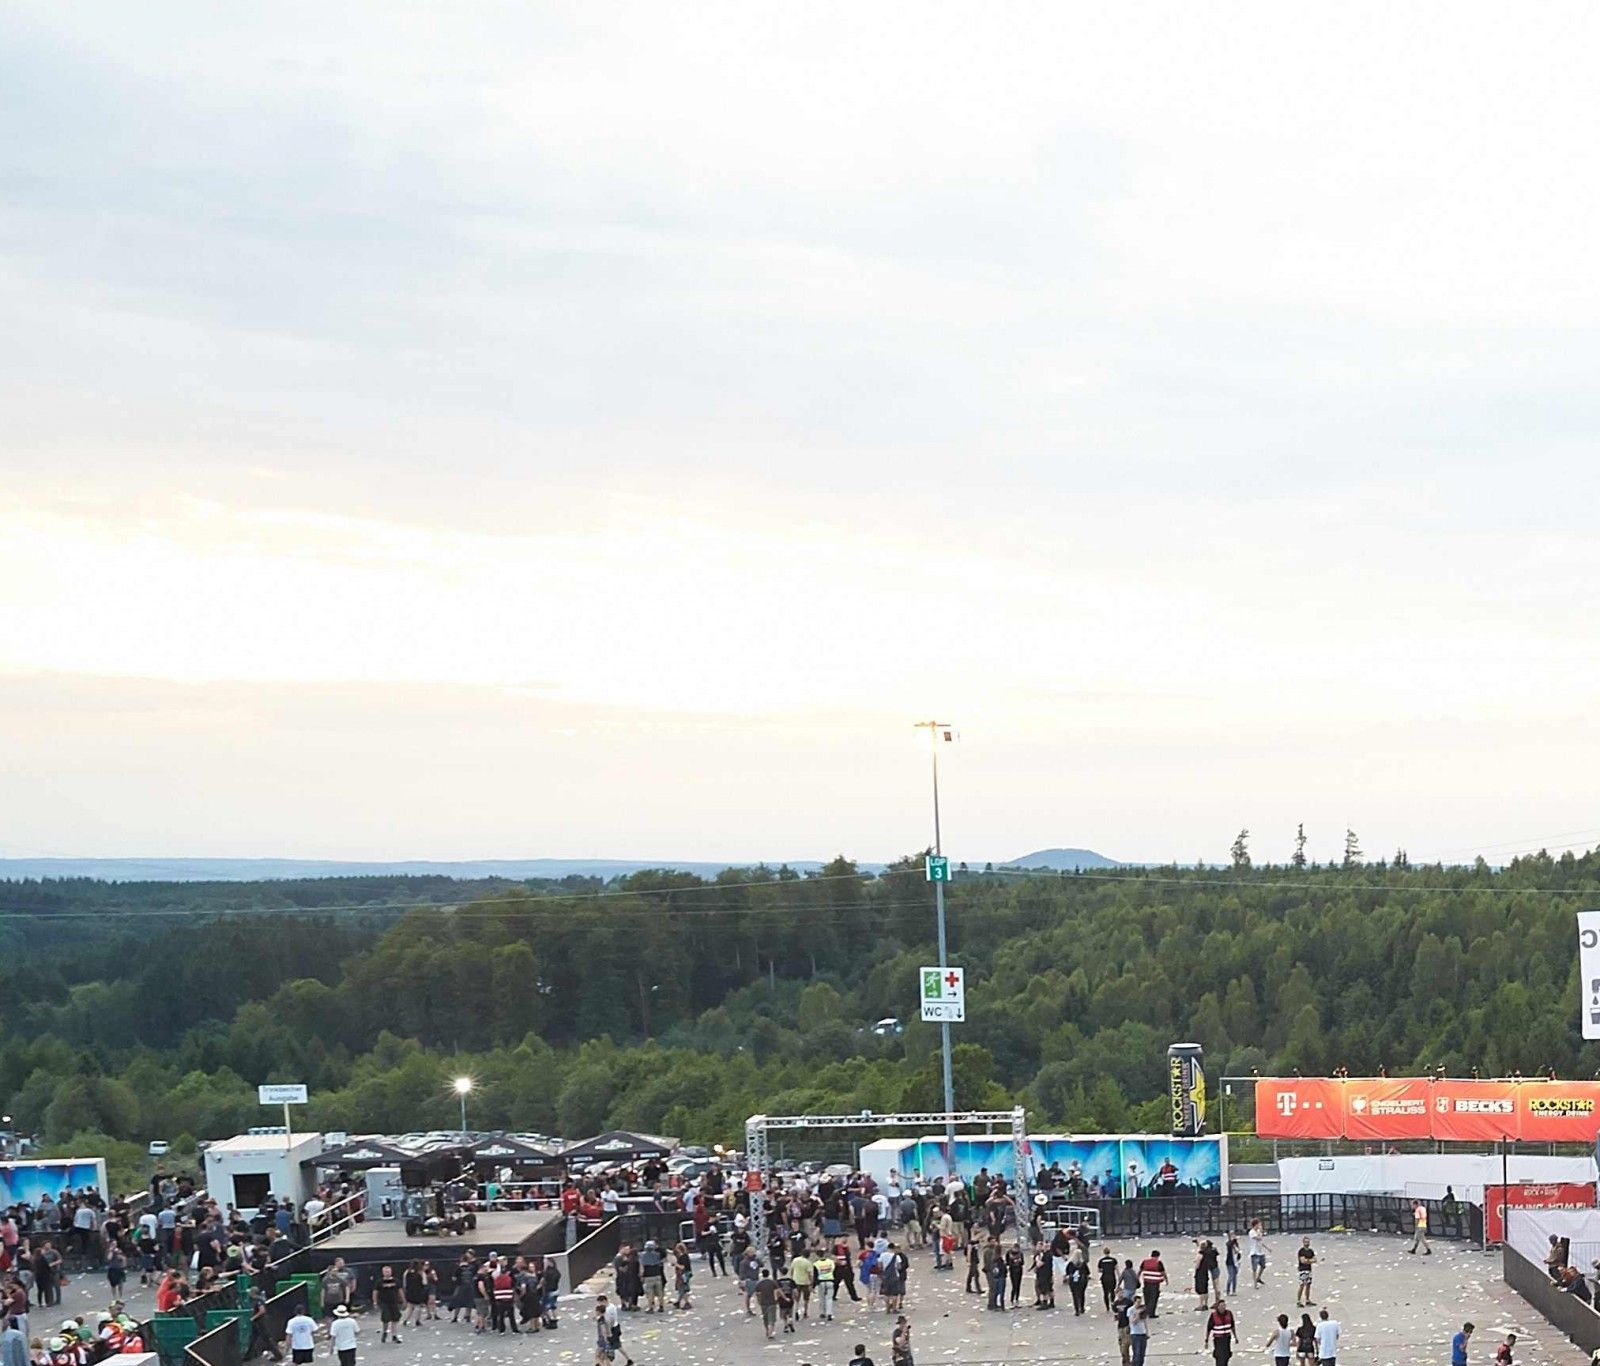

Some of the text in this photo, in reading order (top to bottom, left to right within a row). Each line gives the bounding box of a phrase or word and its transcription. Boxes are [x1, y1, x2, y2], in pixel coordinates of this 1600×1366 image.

[935, 867, 942, 879] 3
[924, 1007, 942, 1017] WC
[1371, 1106, 1426, 1115] STRAUSS
